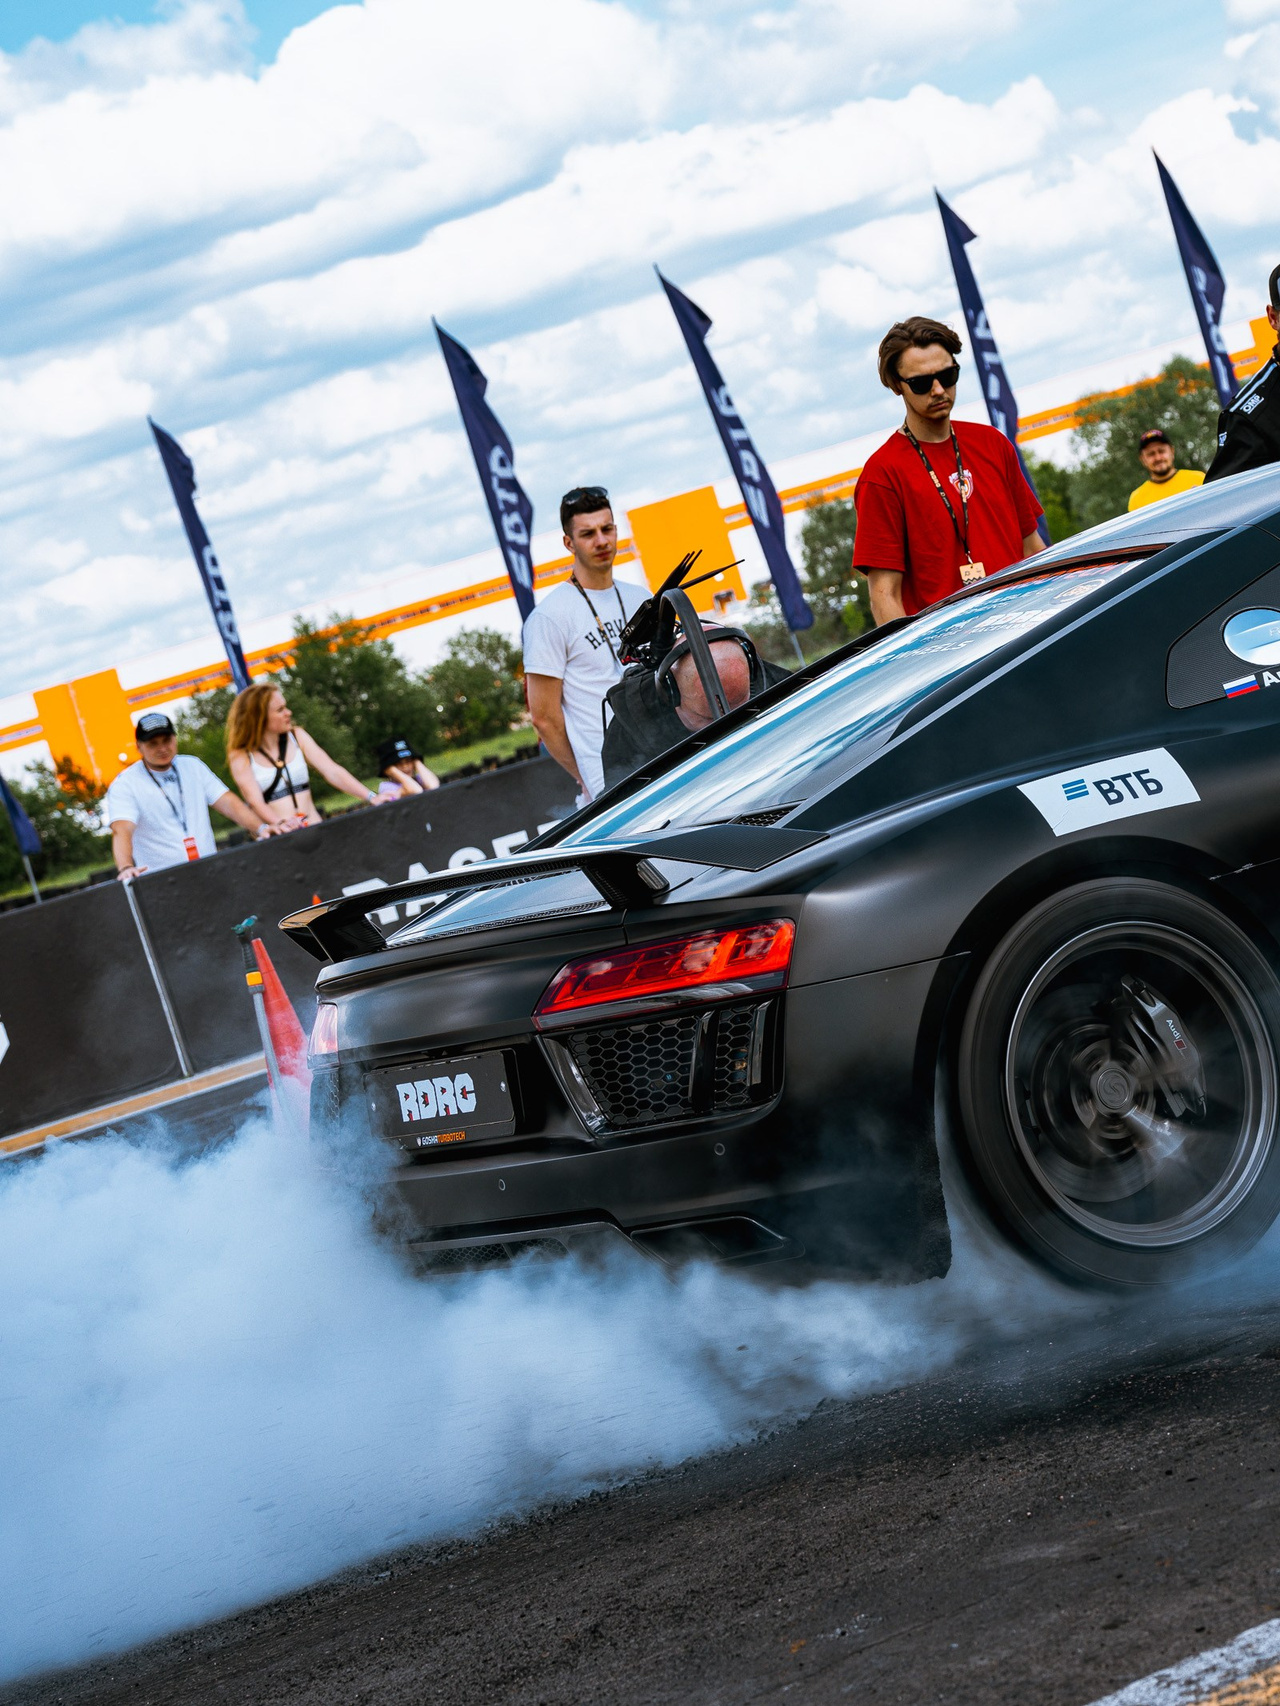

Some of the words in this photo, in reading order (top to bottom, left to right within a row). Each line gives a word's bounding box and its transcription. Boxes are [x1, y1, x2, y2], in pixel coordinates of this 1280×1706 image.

[1092, 768, 1164, 806] ВТБ
[1166, 1019, 1182, 1040] Audi
[396, 1072, 477, 1122] RDRC
